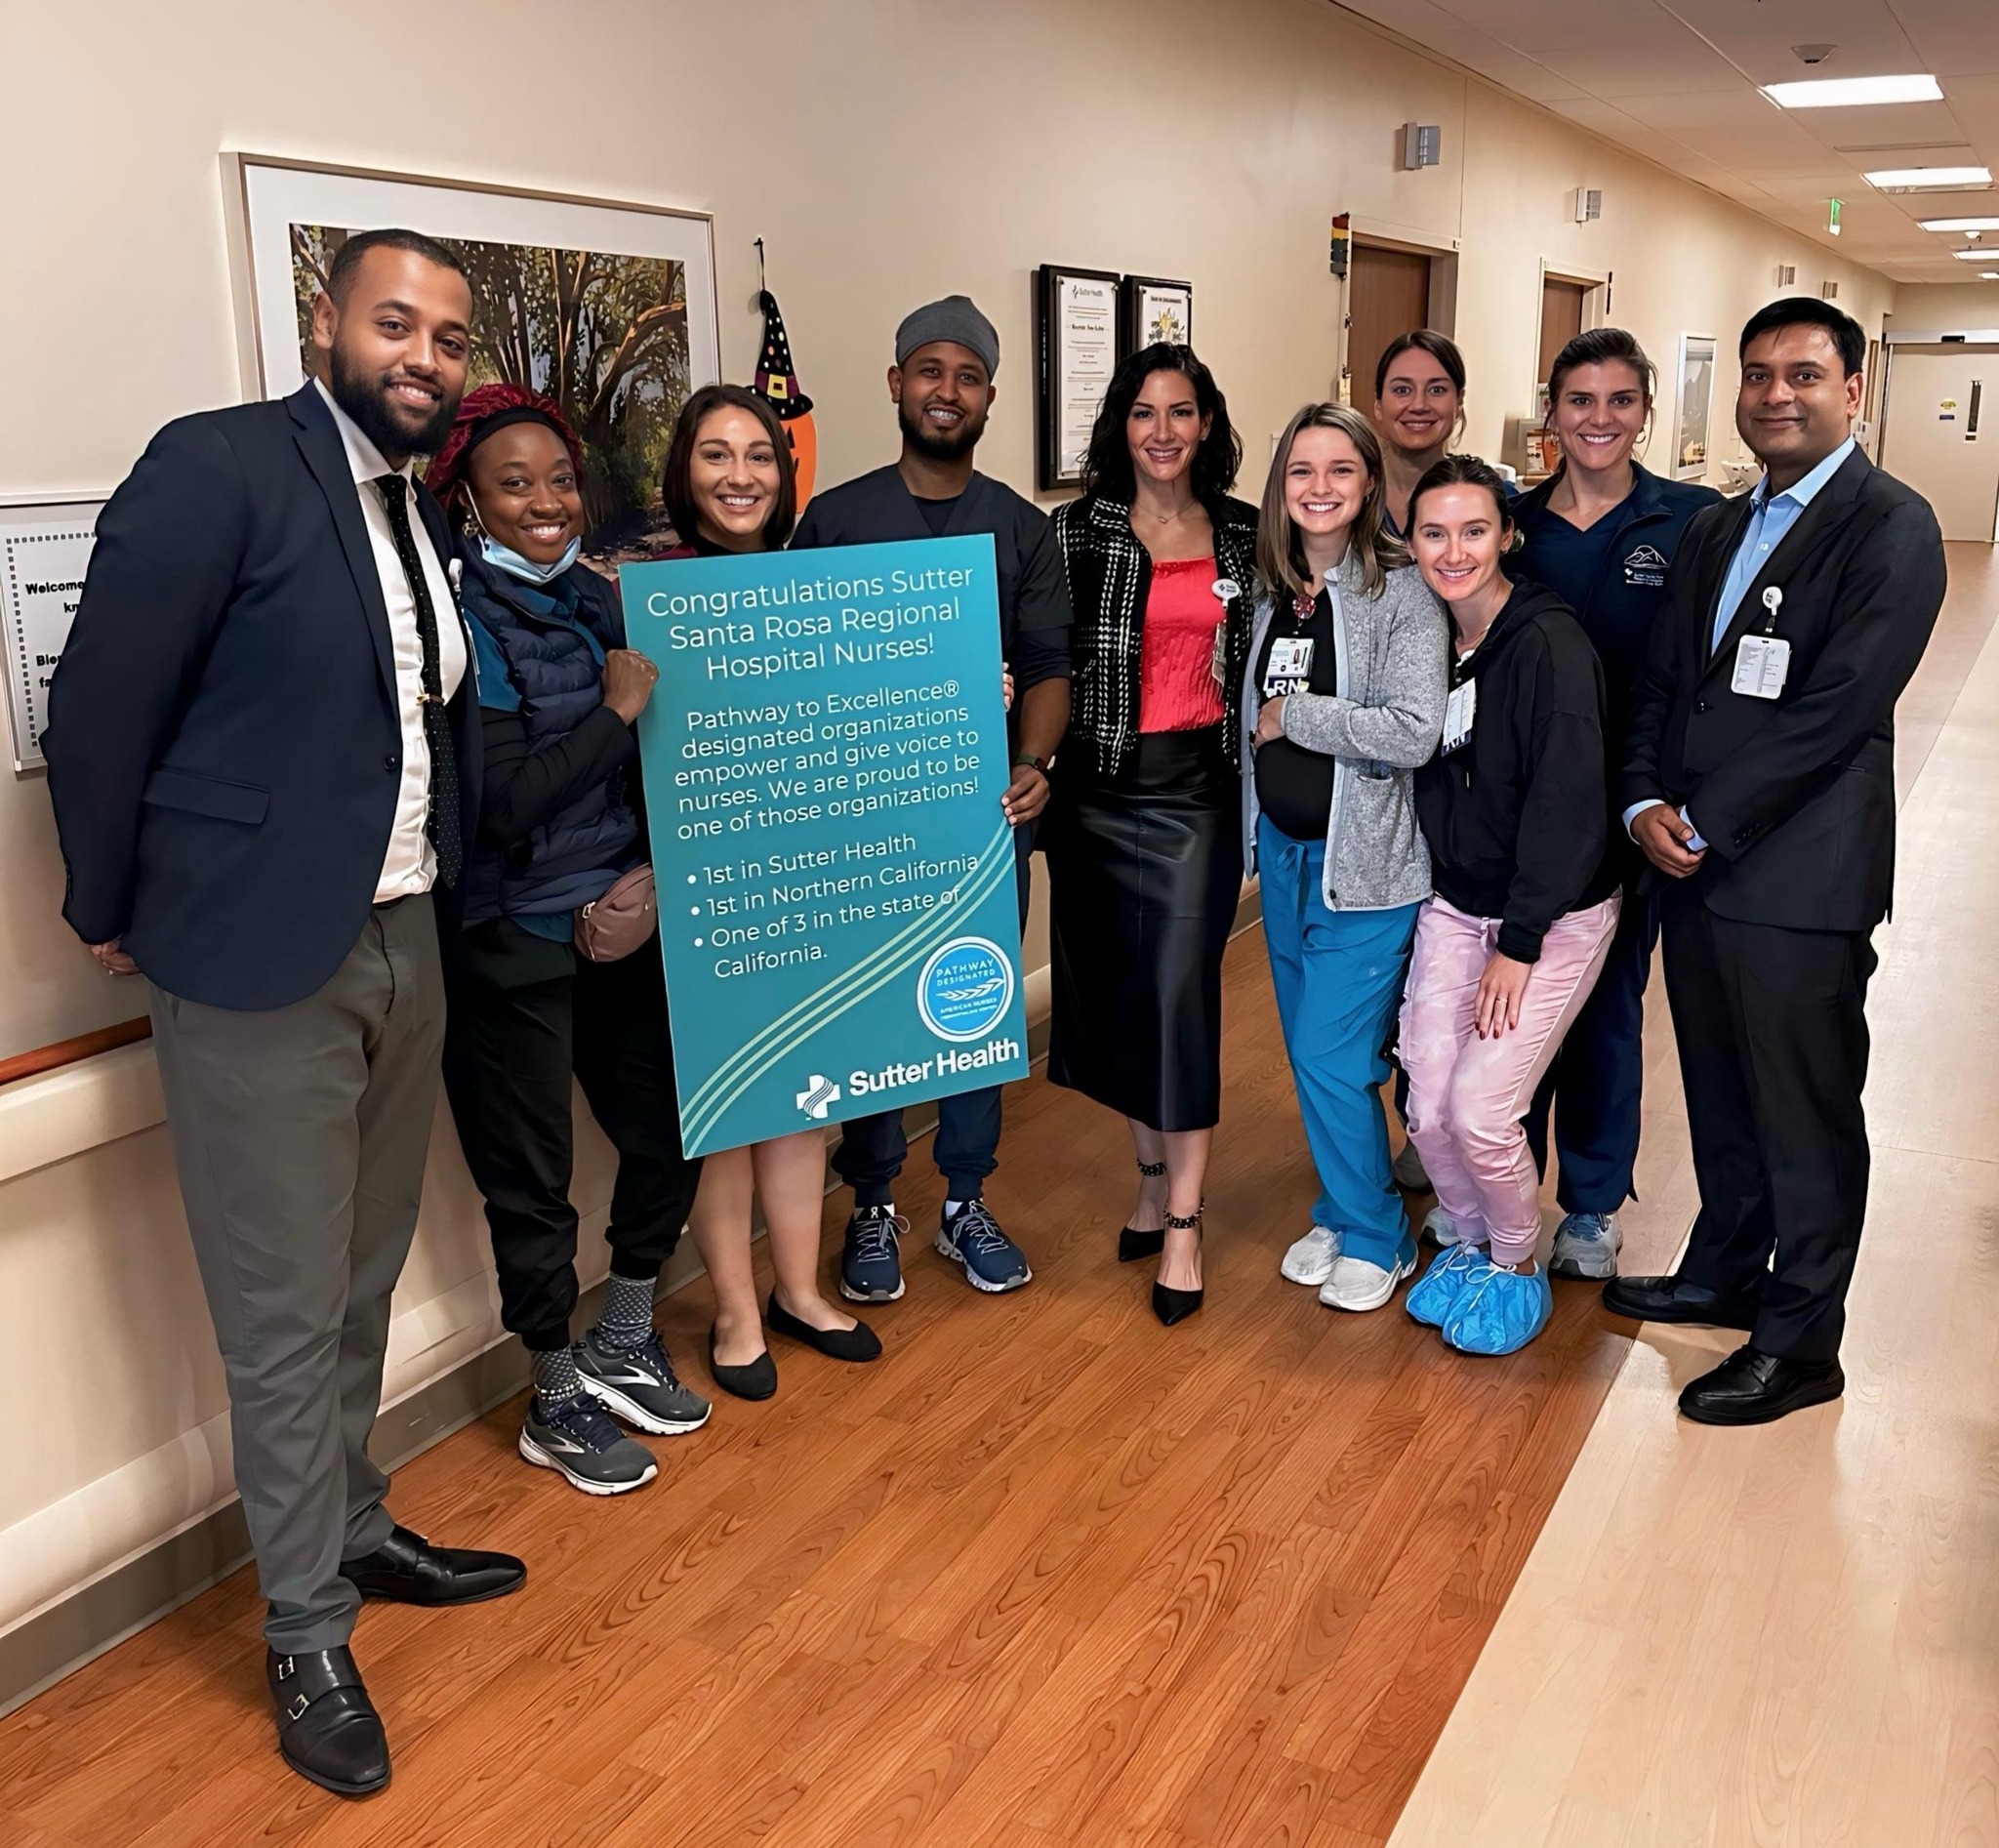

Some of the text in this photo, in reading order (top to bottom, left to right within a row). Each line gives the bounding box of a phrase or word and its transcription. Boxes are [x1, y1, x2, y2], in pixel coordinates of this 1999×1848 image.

[647, 566, 973, 617] Congratulations Sutter
[670, 597, 959, 649] Santa Rosa Regional
[708, 633, 934, 679] Hospital Nurses!
[682, 705, 968, 759] designated organizations
[687, 703, 790, 731] Pathway
[796, 698, 820, 718] to
[674, 730, 979, 787] empower and give voice to
[679, 756, 980, 813] nurses. We are proud to be
[677, 777, 979, 840] one of those organizations!
[704, 833, 917, 884] 1st in Sutter Health
[708, 853, 978, 917] 1st in Northern California
[711, 885, 960, 948] One of 3 in the state of
[714, 945, 828, 978] California.
[937, 958, 994, 977] PATHWAY
[937, 968, 996, 986] DESIGNATED
[849, 1038, 1019, 1097] Sutter Health
